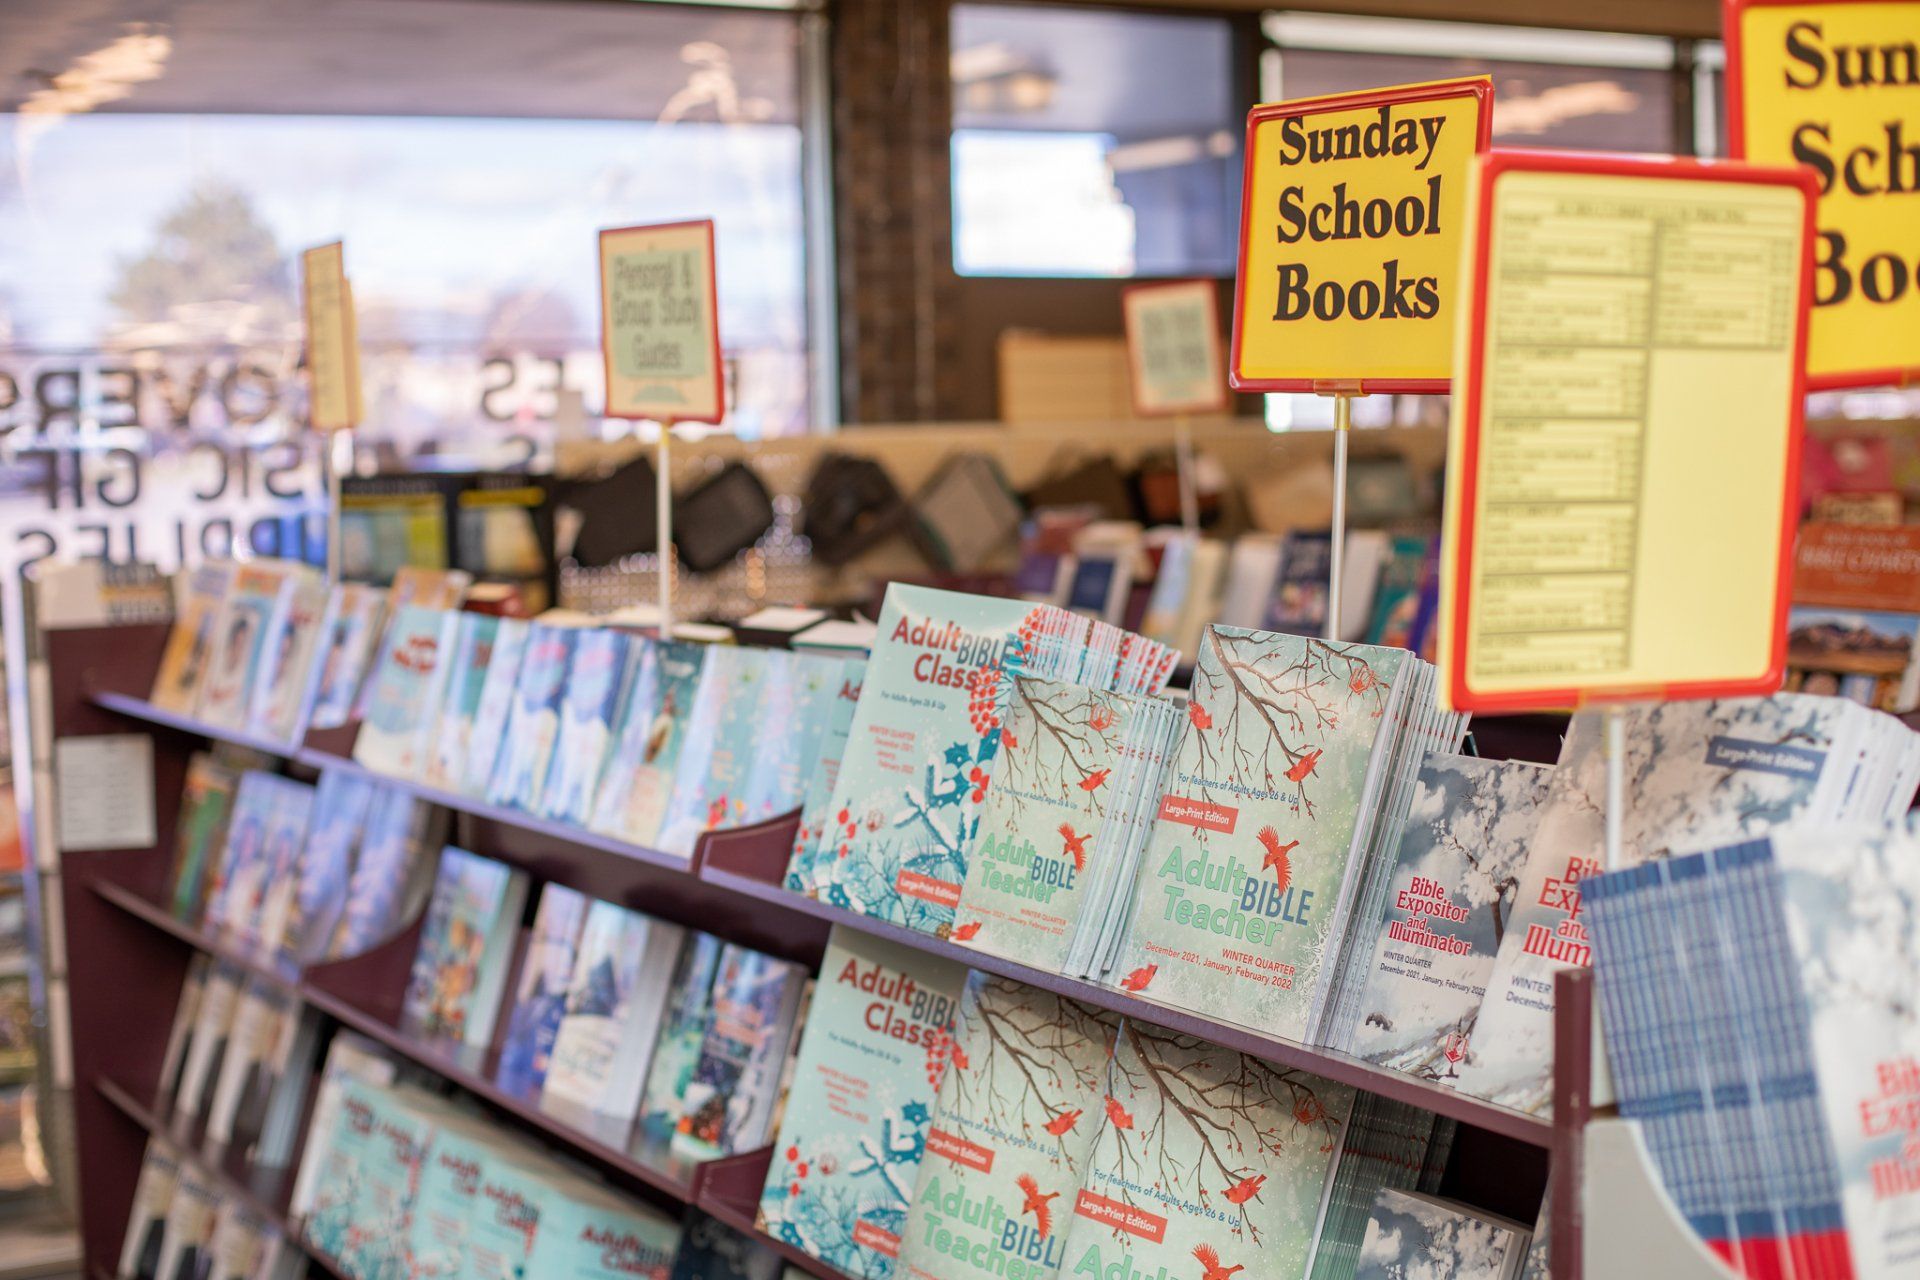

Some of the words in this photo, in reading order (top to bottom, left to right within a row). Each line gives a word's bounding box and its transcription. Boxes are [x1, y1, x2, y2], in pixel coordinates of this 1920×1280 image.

[1279, 106, 1446, 170] Sunday
[1276, 175, 1442, 244] School
[1273, 260, 1440, 322] Books
[1814, 230, 1920, 307] Bo
[890, 614, 962, 652] Adult
[957, 633, 1013, 673] BIBLE
[913, 652, 980, 692] Class
[1177, 772, 1189, 783] For
[1190, 774, 1219, 791] Teachers
[1220, 780, 1229, 791] of
[1229, 781, 1250, 796] Adults
[1251, 787, 1269, 800] Ages
[1269, 789, 1279, 800] 26
[1280, 792, 1287, 802] &
[1288, 793, 1299, 805] Up
[1165, 803, 1204, 821] Large-Print
[1204, 810, 1230, 825] Edition
[978, 832, 1037, 869] Adult
[1031, 855, 1077, 890] BIBLE
[980, 860, 1058, 905] Teacher
[1157, 845, 1248, 897] Adult
[1240, 876, 1314, 926] BIBLE
[1395, 890, 1469, 924] Expositor
[1409, 876, 1445, 901] Bible
[1163, 884, 1284, 947] Teacher
[1388, 920, 1472, 957] Illuminator
[1406, 915, 1427, 931] and
[838, 959, 917, 1007] Adult
[1144, 941, 1180, 959] December
[1203, 957, 1234, 976] January,
[1235, 964, 1270, 986] February
[1271, 975, 1292, 990] 2022
[1222, 948, 1254, 966] WINTER
[1255, 956, 1296, 977] QUARTER
[1379, 963, 1406, 978] December
[1445, 978, 1471, 995] February
[1471, 984, 1486, 997] 2022
[1383, 950, 1405, 965] WINTER
[1405, 955, 1433, 970] QUARTER
[1511, 975, 1552, 995] WINTER
[864, 1002, 936, 1050] Class
[1080, 1197, 1125, 1222] Large-Print
[1125, 1212, 1157, 1233] Edition
[1093, 1168, 1107, 1180] For
[1108, 1173, 1142, 1194] Teachers
[1143, 1184, 1154, 1196] of
[1154, 1189, 1180, 1207] Adults
[1181, 1200, 1204, 1216] Ages
[1204, 1207, 1216, 1219] 26
[1218, 1211, 1225, 1222] &
[1228, 1212, 1241, 1228] Up
[920, 1175, 1007, 1236] Adult
[1000, 1218, 1067, 1271] BIBL
[923, 1211, 1045, 1280] Teacher
